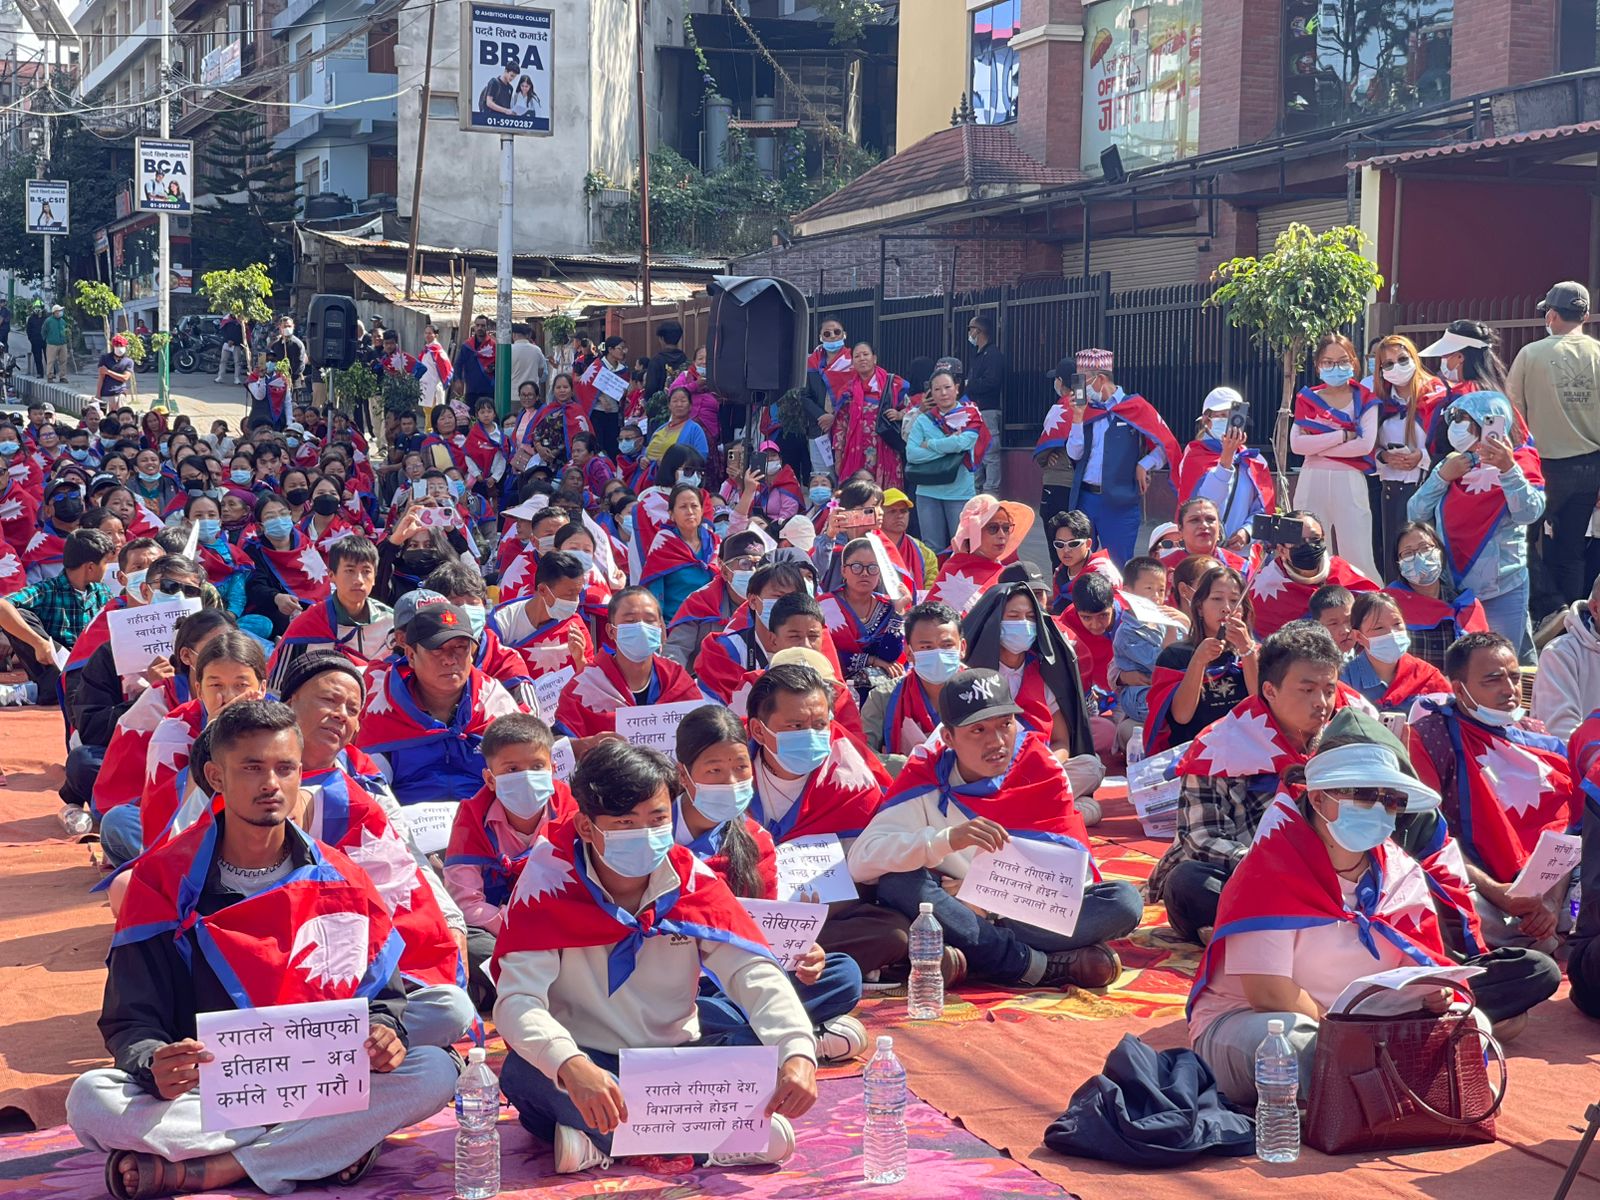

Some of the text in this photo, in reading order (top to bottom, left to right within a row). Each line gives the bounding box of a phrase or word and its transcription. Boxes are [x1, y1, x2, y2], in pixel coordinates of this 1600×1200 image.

[481, 10, 507, 18] AMBITION
[479, 39, 544, 71] BBA
[487, 117, 533, 128] 01-5970287
[144, 158, 187, 175] BCA
[626, 713, 657, 728] रगतले
[628, 731, 666, 746] इतिहास
[992, 858, 1021, 873] रगतले
[988, 871, 1032, 892] विभाजनले
[1035, 885, 1059, 899] होइन
[975, 883, 1009, 899] एकताले
[1013, 894, 1047, 911] उज्यालो
[762, 912, 819, 932] लेखिएको
[782, 939, 806, 950] अब
[216, 1013, 361, 1047] रगतले लेखिएको
[221, 1054, 291, 1079] इतिहास
[327, 1048, 358, 1066] अब
[216, 1083, 267, 1108] कर्मले
[276, 1084, 308, 1108] पूरा
[645, 1081, 682, 1097] रगतले
[646, 1100, 704, 1116] विभाजनले
[709, 1099, 739, 1114] होइन
[632, 1119, 676, 1136] एकताले
[682, 1117, 727, 1133] उज्यालो
[731, 1117, 756, 1133] होस्
